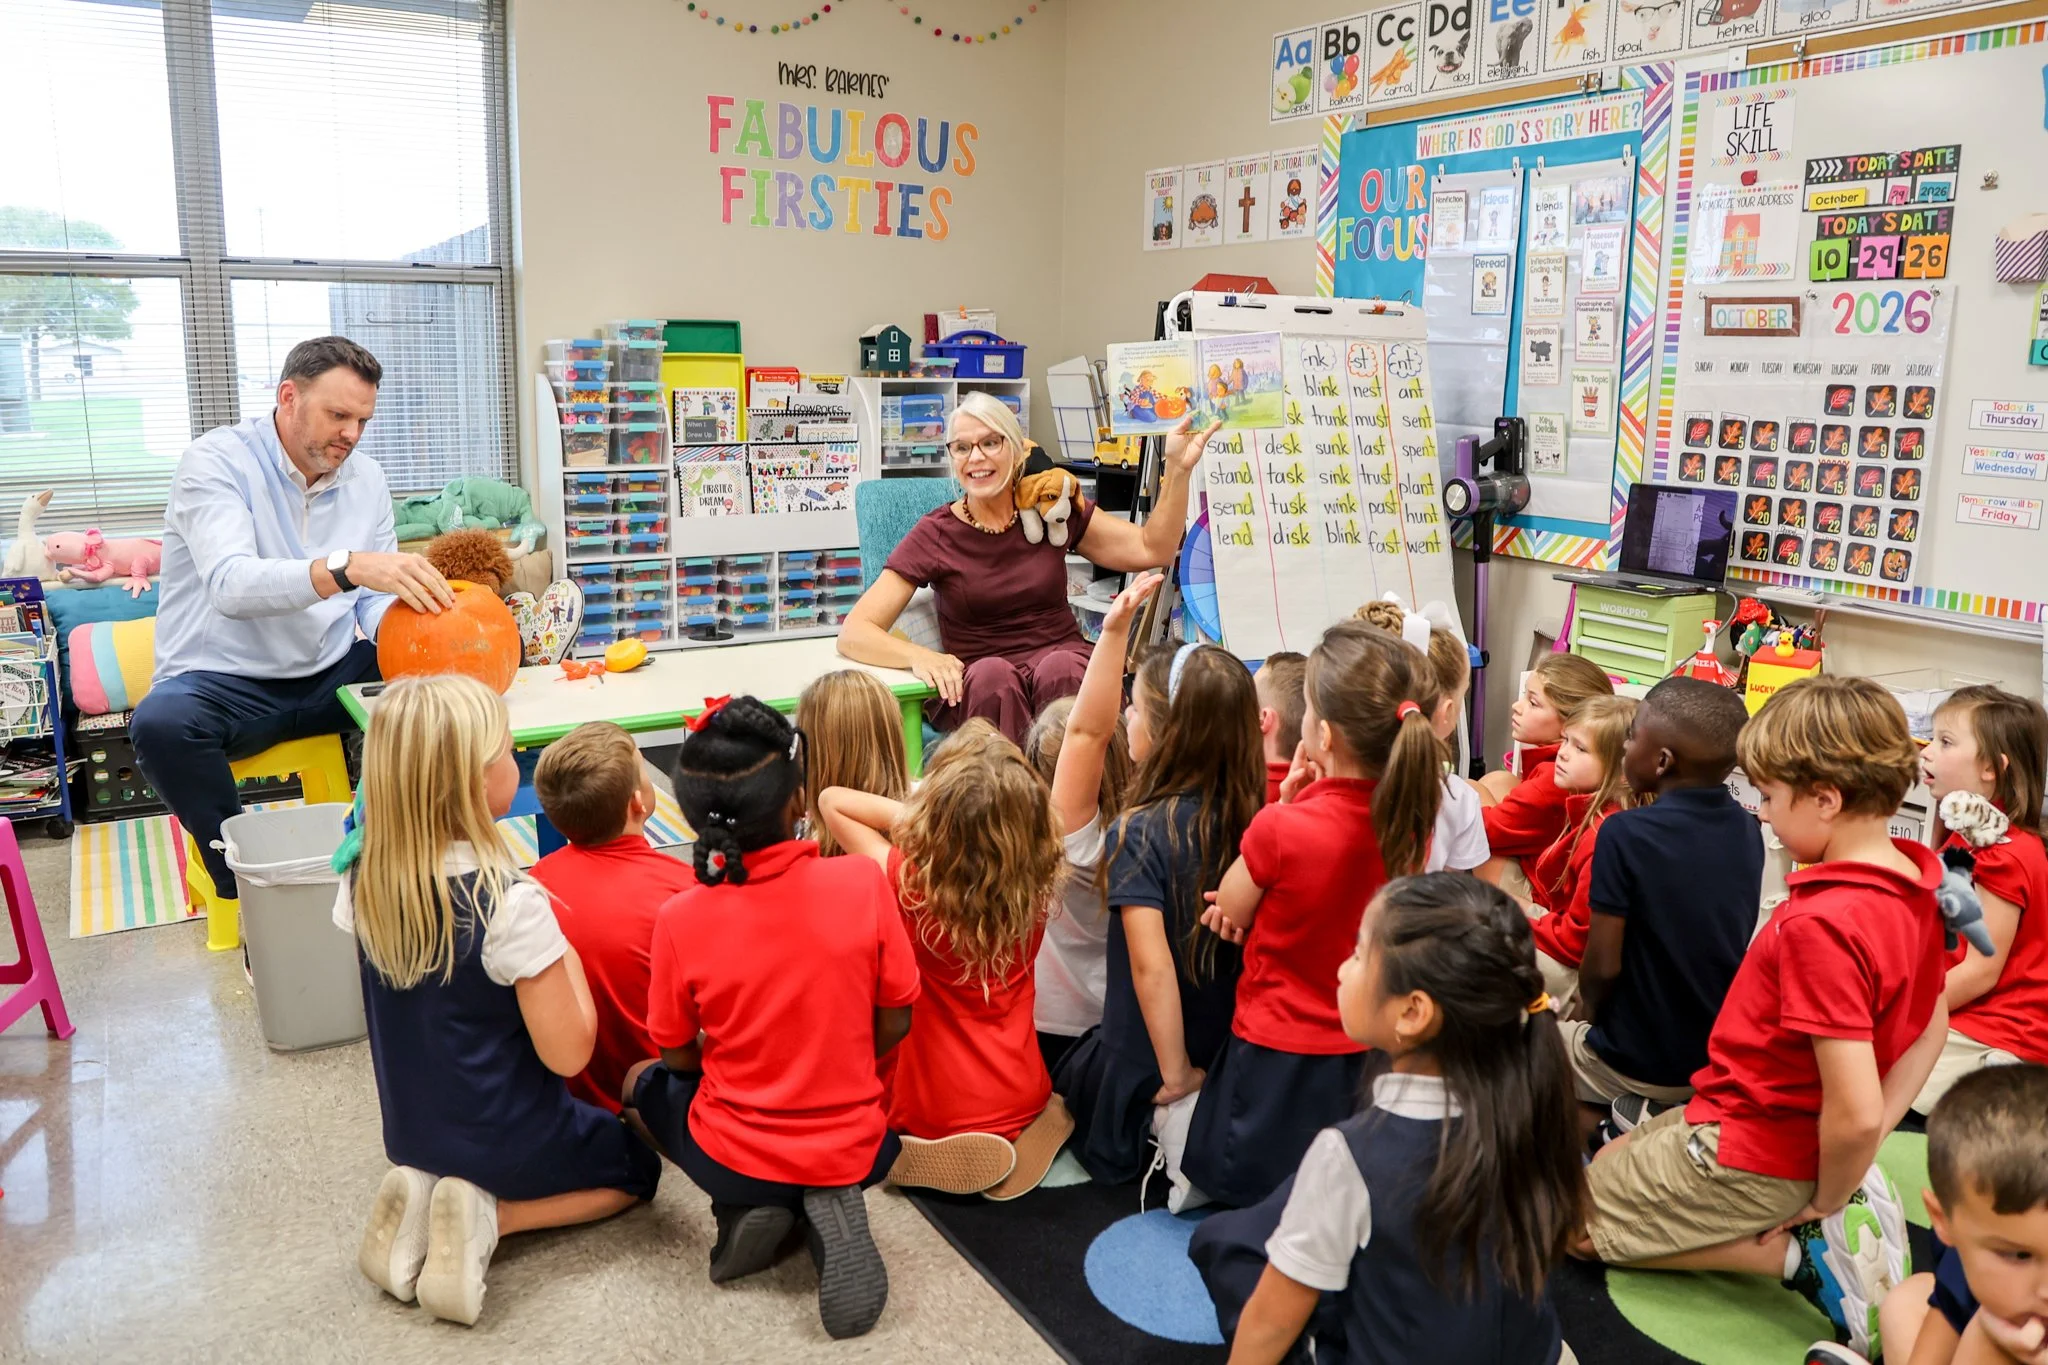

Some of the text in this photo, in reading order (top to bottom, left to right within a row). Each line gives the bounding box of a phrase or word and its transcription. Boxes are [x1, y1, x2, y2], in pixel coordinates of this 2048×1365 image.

[1429, 0, 1472, 37] Dd
[1800, 9, 1831, 26] igloo
[1376, 14, 1415, 47] Cc
[1716, 20, 1759, 40] helmet
[1324, 25, 1361, 61] Bb
[1275, 37, 1312, 70] Aa
[1582, 49, 1600, 61] fish
[778, 61, 890, 99] MRS. BARNES'
[1452, 73, 1470, 83] dog
[1290, 103, 1311, 115] apple
[1733, 101, 1775, 130] LIFE
[707, 95, 980, 178] FABULOUS
[1419, 101, 1642, 157] WHERE IS GOD'S STORY HERE?
[1726, 128, 1778, 157] SKILL
[1273, 154, 1317, 172] RESTORATION
[1847, 148, 1955, 173] TODAYS DATE
[1198, 170, 1211, 184] FALL
[1228, 161, 1268, 179] REDEMPTION
[1151, 176, 1177, 190] CREATION
[1359, 164, 1426, 213] OUR
[719, 166, 953, 241] FIRSTIES
[1435, 195, 1464, 204] Nonfiction
[1483, 194, 1509, 205] Ideas
[1736, 196, 1755, 207] YOUR
[1757, 194, 1794, 206] ADDRESS
[1815, 186, 1948, 206] October 29 2026
[1535, 201, 1564, 212] blends
[1821, 210, 1948, 236] TODAY'S DATE
[1339, 213, 1430, 262] FOCUS
[1475, 258, 1506, 268] Reread
[1817, 243, 1943, 271] 10 29 26
[1715, 308, 1788, 328] OCTOBER
[1832, 289, 1932, 335] 2026
[1303, 344, 1416, 370] -nk -st -nt
[1694, 361, 1933, 376] SUNDAY MONDAY TUESDAY WEDNESDAY THURSDAY FRIDAY SATURDAY
[1303, 374, 1340, 398] blink
[1353, 375, 1382, 398] nest
[1398, 377, 1425, 399] ant
[1573, 375, 1609, 384] Main Topic
[793, 404, 844, 414] COWPOKES
[1311, 404, 1432, 429] trunk must sent
[1888, 404, 1895, 416] 2
[1925, 405, 1932, 418] 3
[1993, 402, 2035, 414] Today is
[1535, 425, 1558, 434] Details
[1539, 416, 1553, 426] Key
[1986, 413, 2038, 428] Thursday
[1207, 430, 1436, 464] sand desk sunk last spent
[1704, 434, 1923, 458] 4 5 6 7 8 9 10
[1968, 447, 2046, 462] Yesterday was
[758, 466, 793, 475] HAPPY
[1975, 461, 2036, 477] Wednesday
[702, 484, 733, 494] FIRSTIES
[1209, 461, 1435, 500] stand task sink trust plant
[1696, 468, 1920, 500] 11 12 13 14 15 16 17
[699, 496, 724, 506] DREAM
[1212, 490, 1439, 525] send tusk wink past hunt
[1961, 495, 2040, 508] Tomorrow will be
[1981, 508, 2018, 525] Friday
[1757, 511, 1916, 541] 20 21 22 23 24
[1216, 519, 1442, 555] lend disk blink fast went
[1756, 548, 1768, 561] 27
[1787, 552, 1799, 566] 28
[1824, 557, 1837, 571] 29
[1858, 562, 1871, 575] 30
[1600, 602, 1649, 618] WORKPRO
[1749, 684, 1775, 694] LUCKY
[1890, 824, 1911, 840] #10
